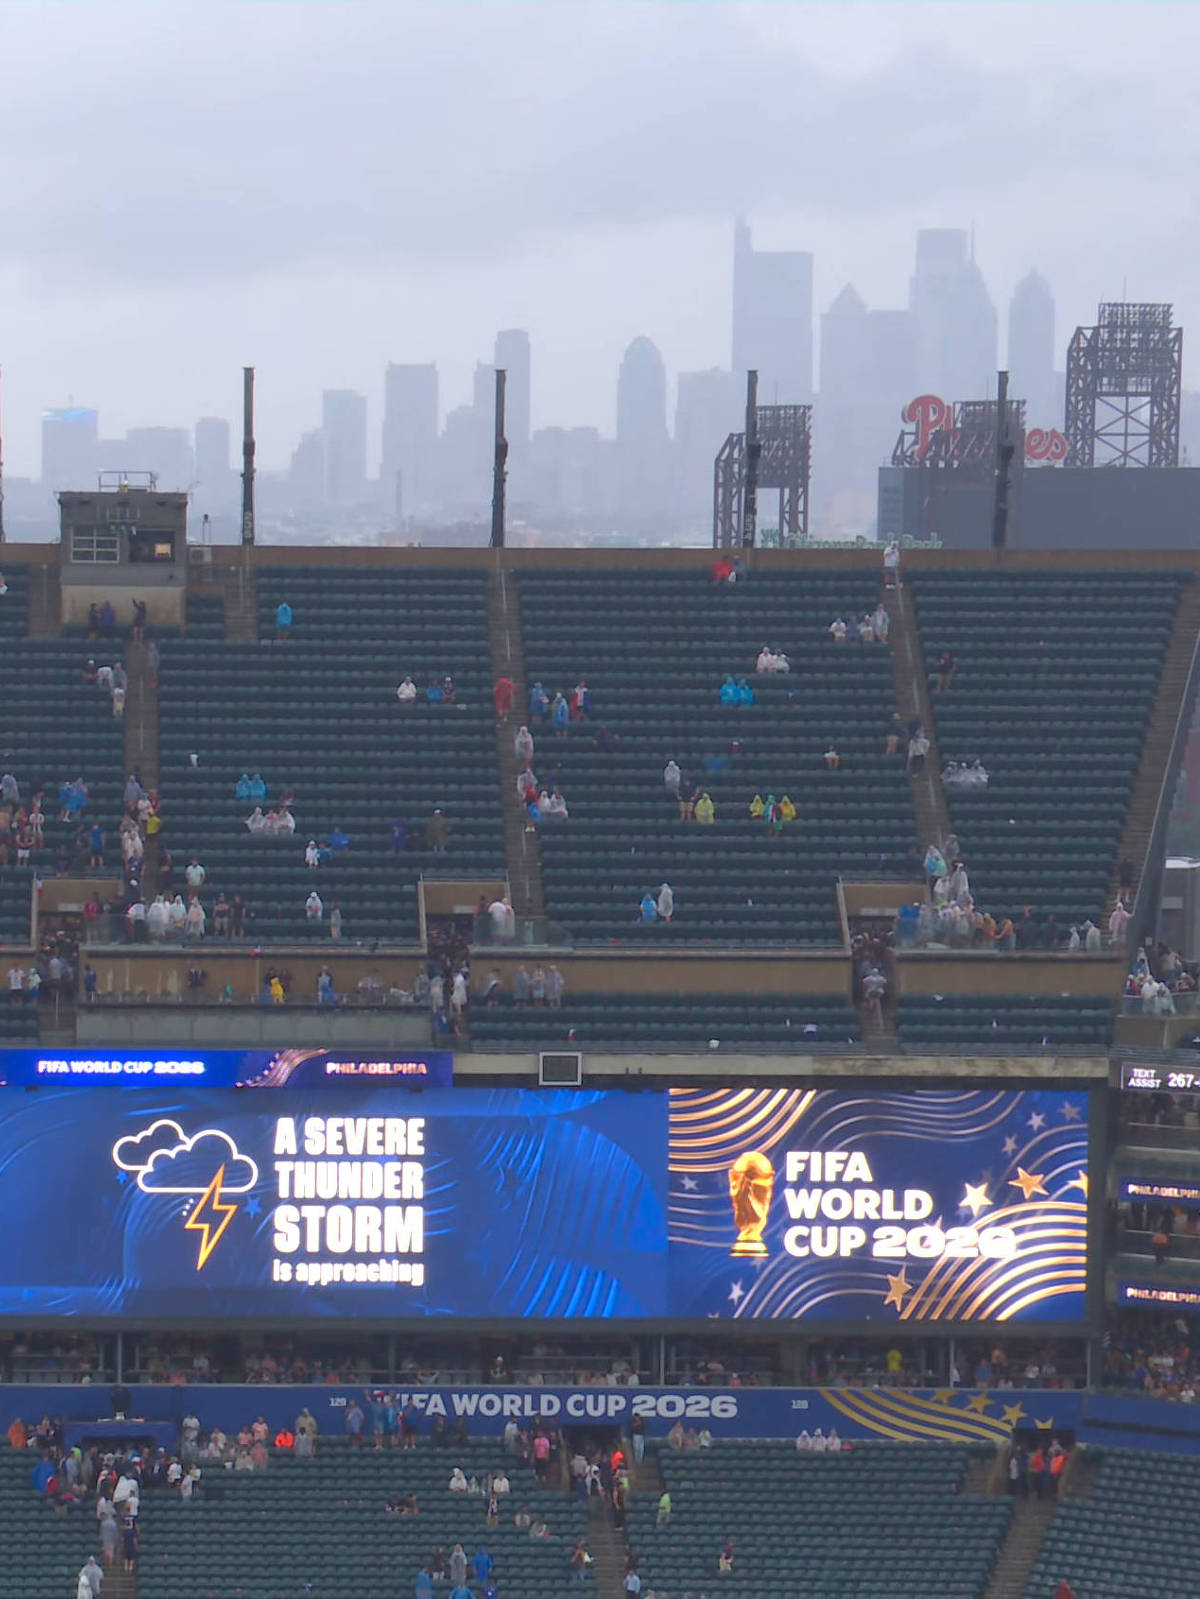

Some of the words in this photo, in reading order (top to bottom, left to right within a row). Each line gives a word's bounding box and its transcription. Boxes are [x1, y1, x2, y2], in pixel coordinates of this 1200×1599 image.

[37, 1060, 69, 1073] FIFA
[70, 1060, 121, 1073] WORLD
[123, 1061, 153, 1074] CUP
[154, 1061, 205, 1074] 2026
[326, 1062, 427, 1075] PHILADELPHIA
[1132, 1068, 1156, 1078] TEXT
[1128, 1078, 1162, 1089] ASSIST
[273, 1118, 297, 1155] A
[304, 1118, 425, 1155] SEVERE
[274, 1161, 424, 1199] THUNDER
[785, 1151, 873, 1182] FIFA
[784, 1189, 933, 1220] WORLD
[273, 1205, 424, 1253] STORM
[783, 1226, 866, 1257] CUP
[871, 1226, 1016, 1258] 2026
[296, 1259, 424, 1287] approaching
[394, 1394, 447, 1416] IFA
[451, 1393, 558, 1417] WORLD
[564, 1393, 627, 1417] CUP
[631, 1394, 738, 1418] 2026
